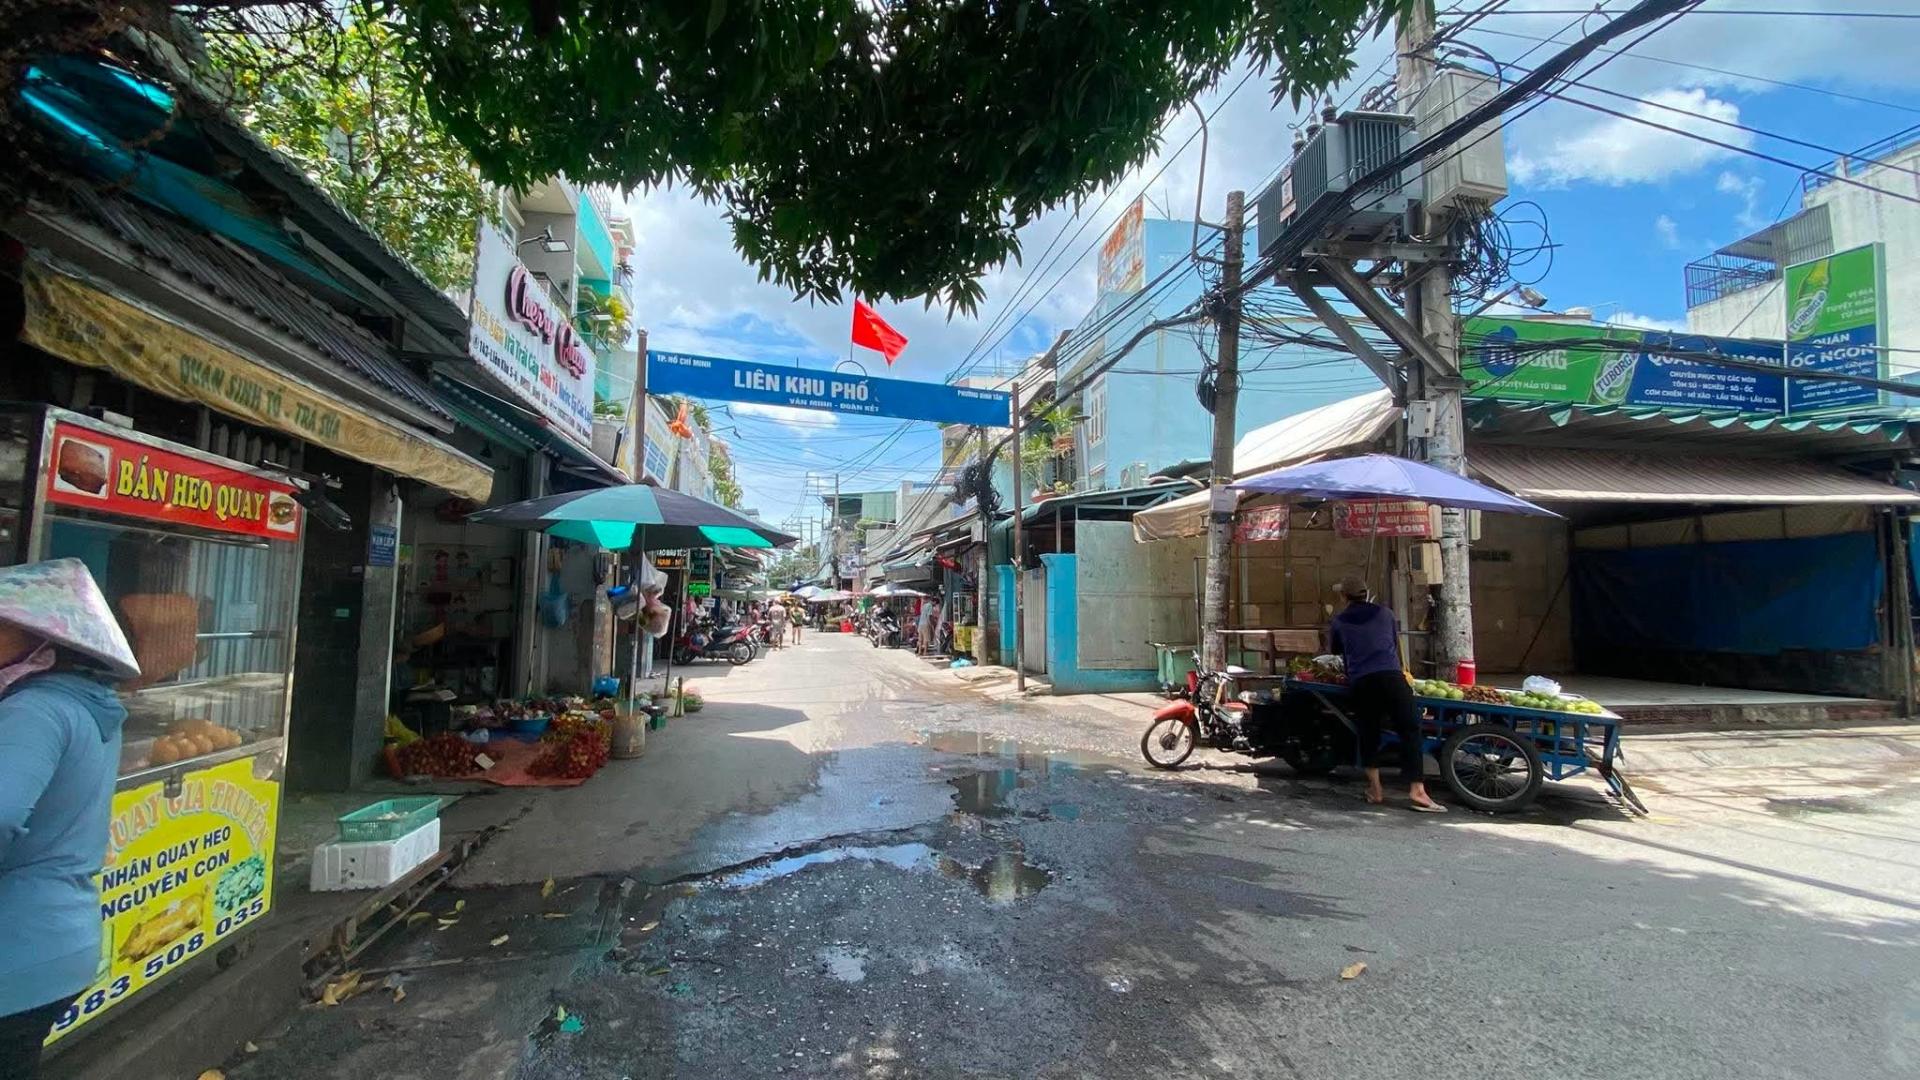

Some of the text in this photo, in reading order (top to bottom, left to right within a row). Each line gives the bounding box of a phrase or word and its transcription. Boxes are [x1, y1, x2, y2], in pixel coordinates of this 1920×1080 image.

[693, 359, 711, 368] MINH
[1596, 354, 1632, 392] TUBORG
[1791, 343, 1874, 367] ỐC NGON
[734, 369, 868, 401] LIÊN KHU PHỐ
[809, 400, 832, 408] MINH
[117, 456, 265, 521] BÁN HEO QUAY
[102, 826, 231, 892] NHẬN QUAY HEO
[100, 850, 230, 920] NGUYÊN CON
[144, 932, 204, 978] 508
[216, 898, 264, 936] 035
